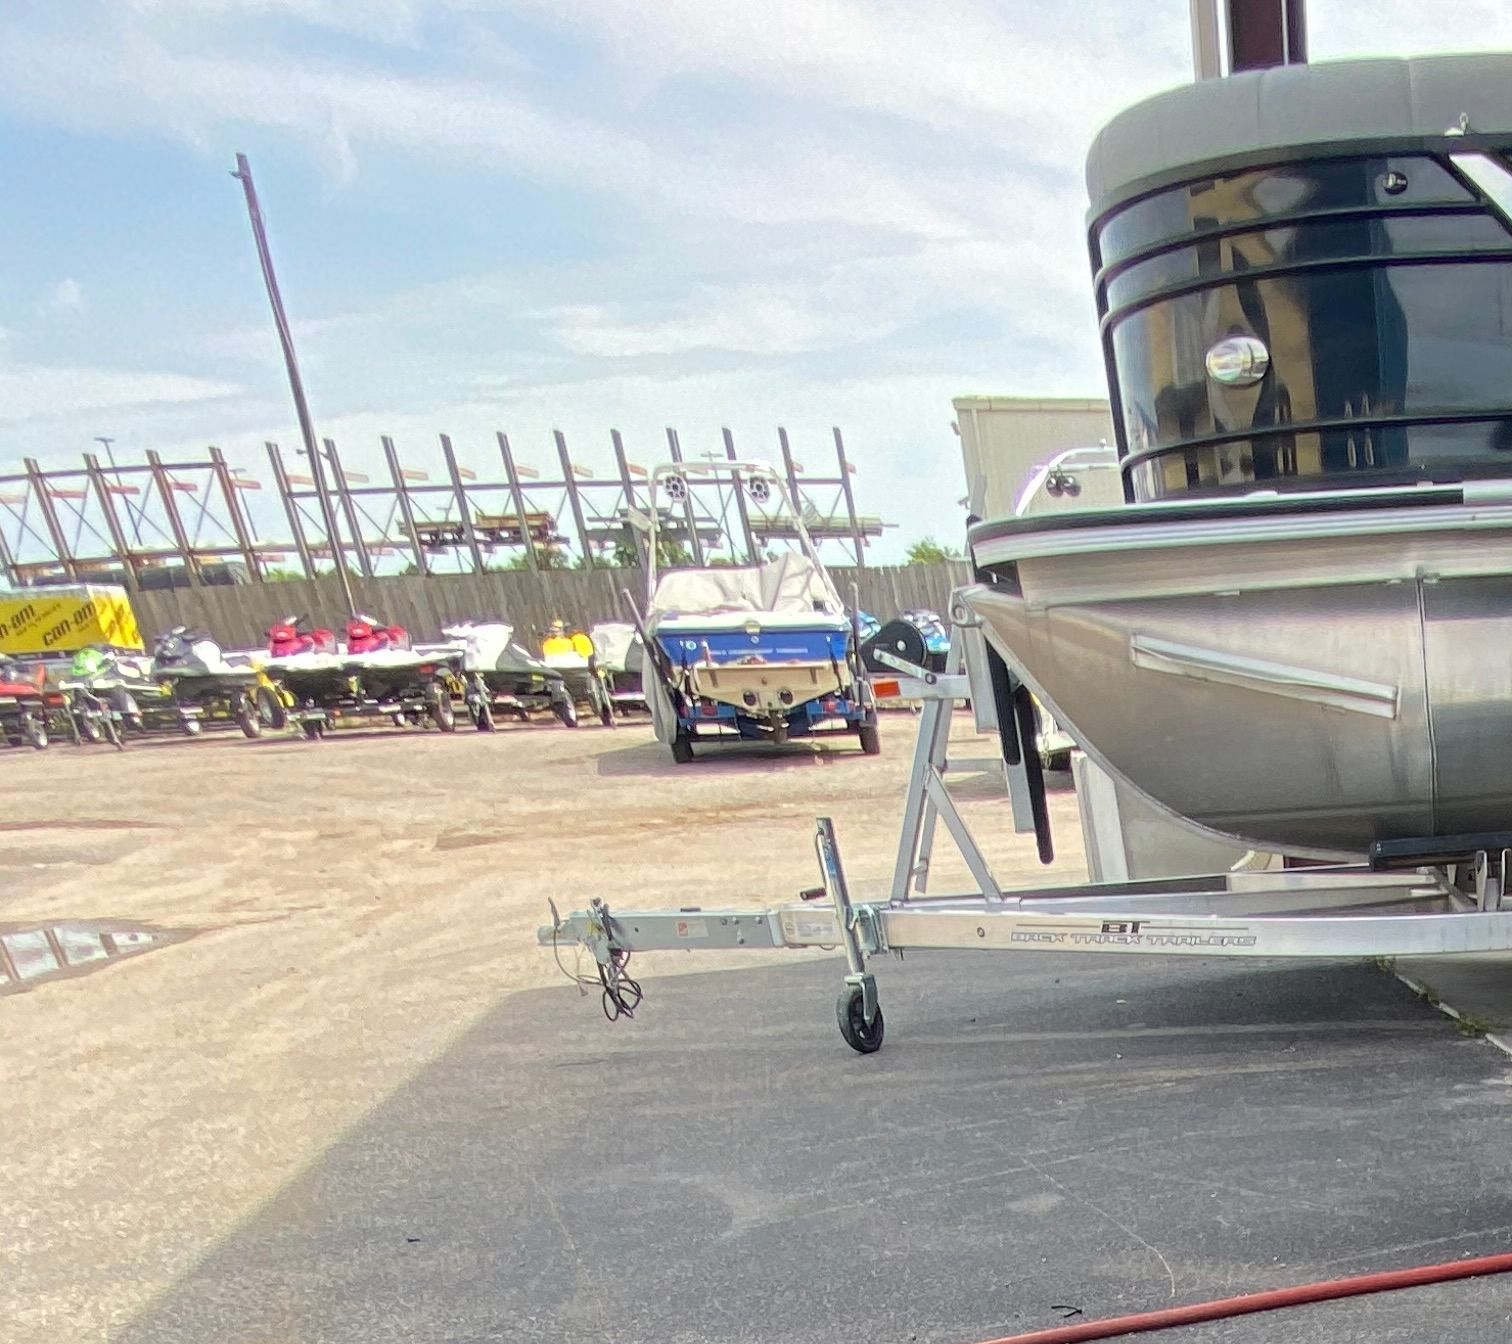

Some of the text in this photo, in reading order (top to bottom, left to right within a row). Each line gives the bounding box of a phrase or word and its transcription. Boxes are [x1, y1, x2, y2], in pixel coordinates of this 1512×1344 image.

[1011, 931, 1257, 947] BACK TRACK TRAILERS
